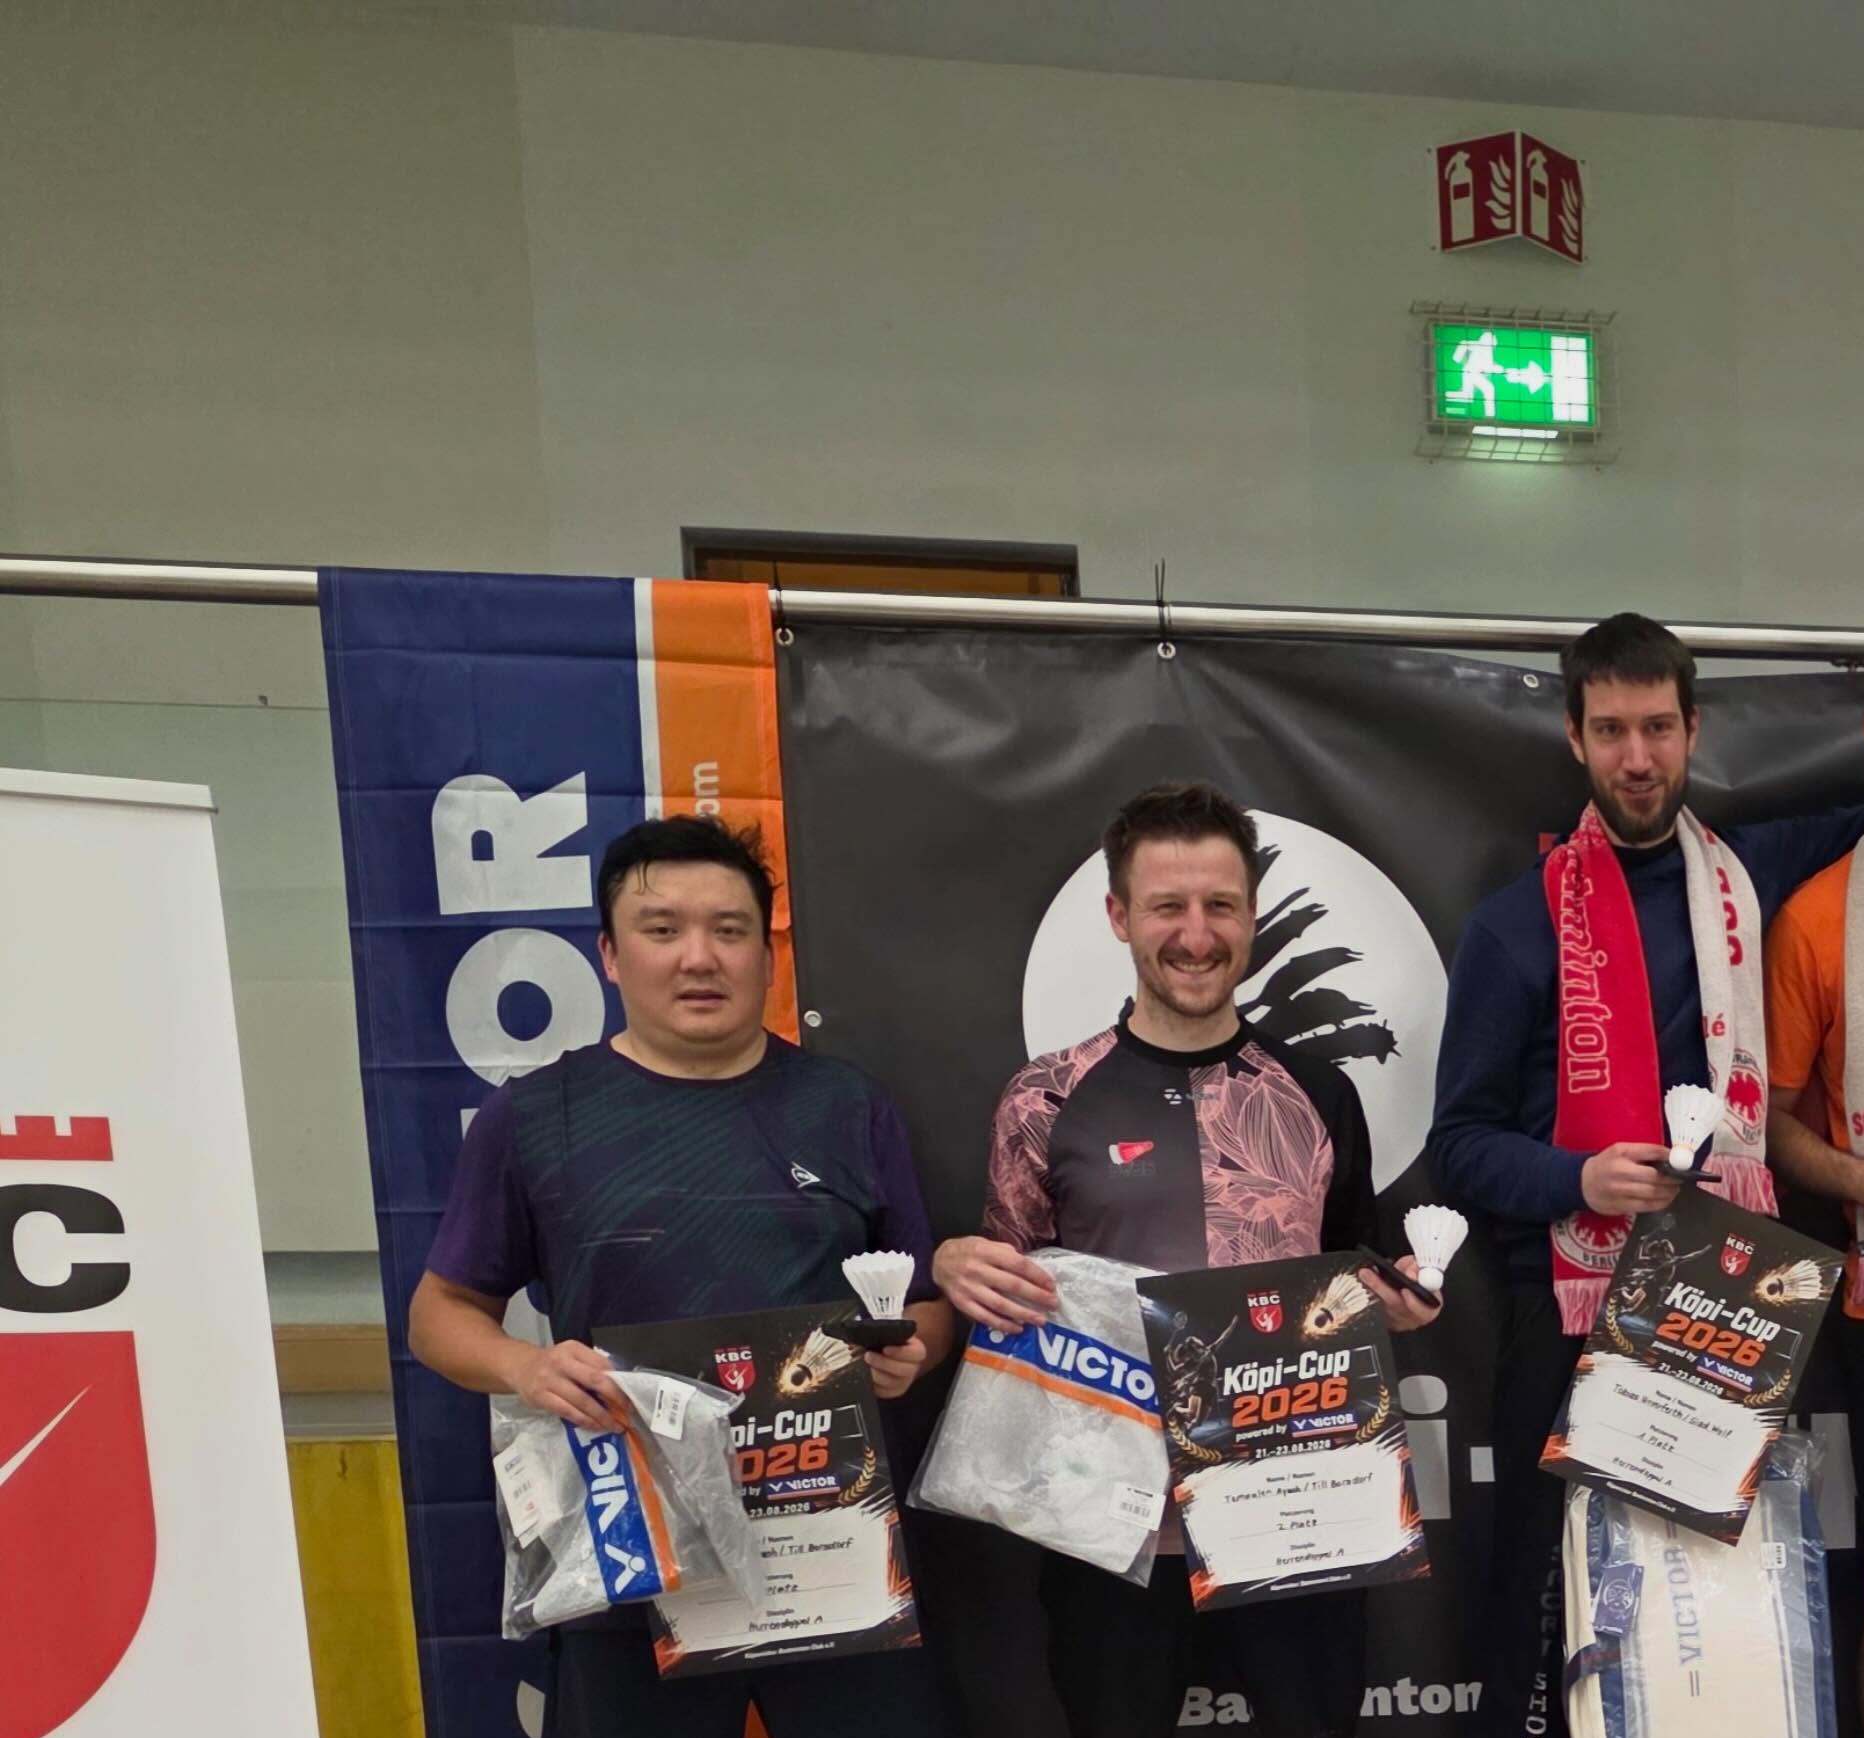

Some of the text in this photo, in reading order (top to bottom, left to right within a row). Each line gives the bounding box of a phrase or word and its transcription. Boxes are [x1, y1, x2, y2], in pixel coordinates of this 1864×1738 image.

[1726, 1236, 1754, 1254] KBC
[1248, 1295, 1280, 1307] KBC
[1665, 1282, 1781, 1342] Köpi-Cup
[715, 1350, 752, 1363] KBC
[1656, 1312, 1766, 1367] 2026
[1038, 1326, 1160, 1406] VICTO
[1223, 1350, 1350, 1395] Köpi-Cup
[1716, 1361, 1754, 1385] VICTOR
[1232, 1377, 1348, 1428] 2026
[730, 1409, 832, 1447] pi-Cup
[1235, 1414, 1354, 1441] powered by VICTOR
[736, 1437, 829, 1483] 026
[786, 1476, 836, 1490] VICTOR
[750, 1502, 810, 1518] 23.08.2026
[1663, 1543, 1702, 1667] VICTOR
[1177, 1677, 1482, 1727] Banton
